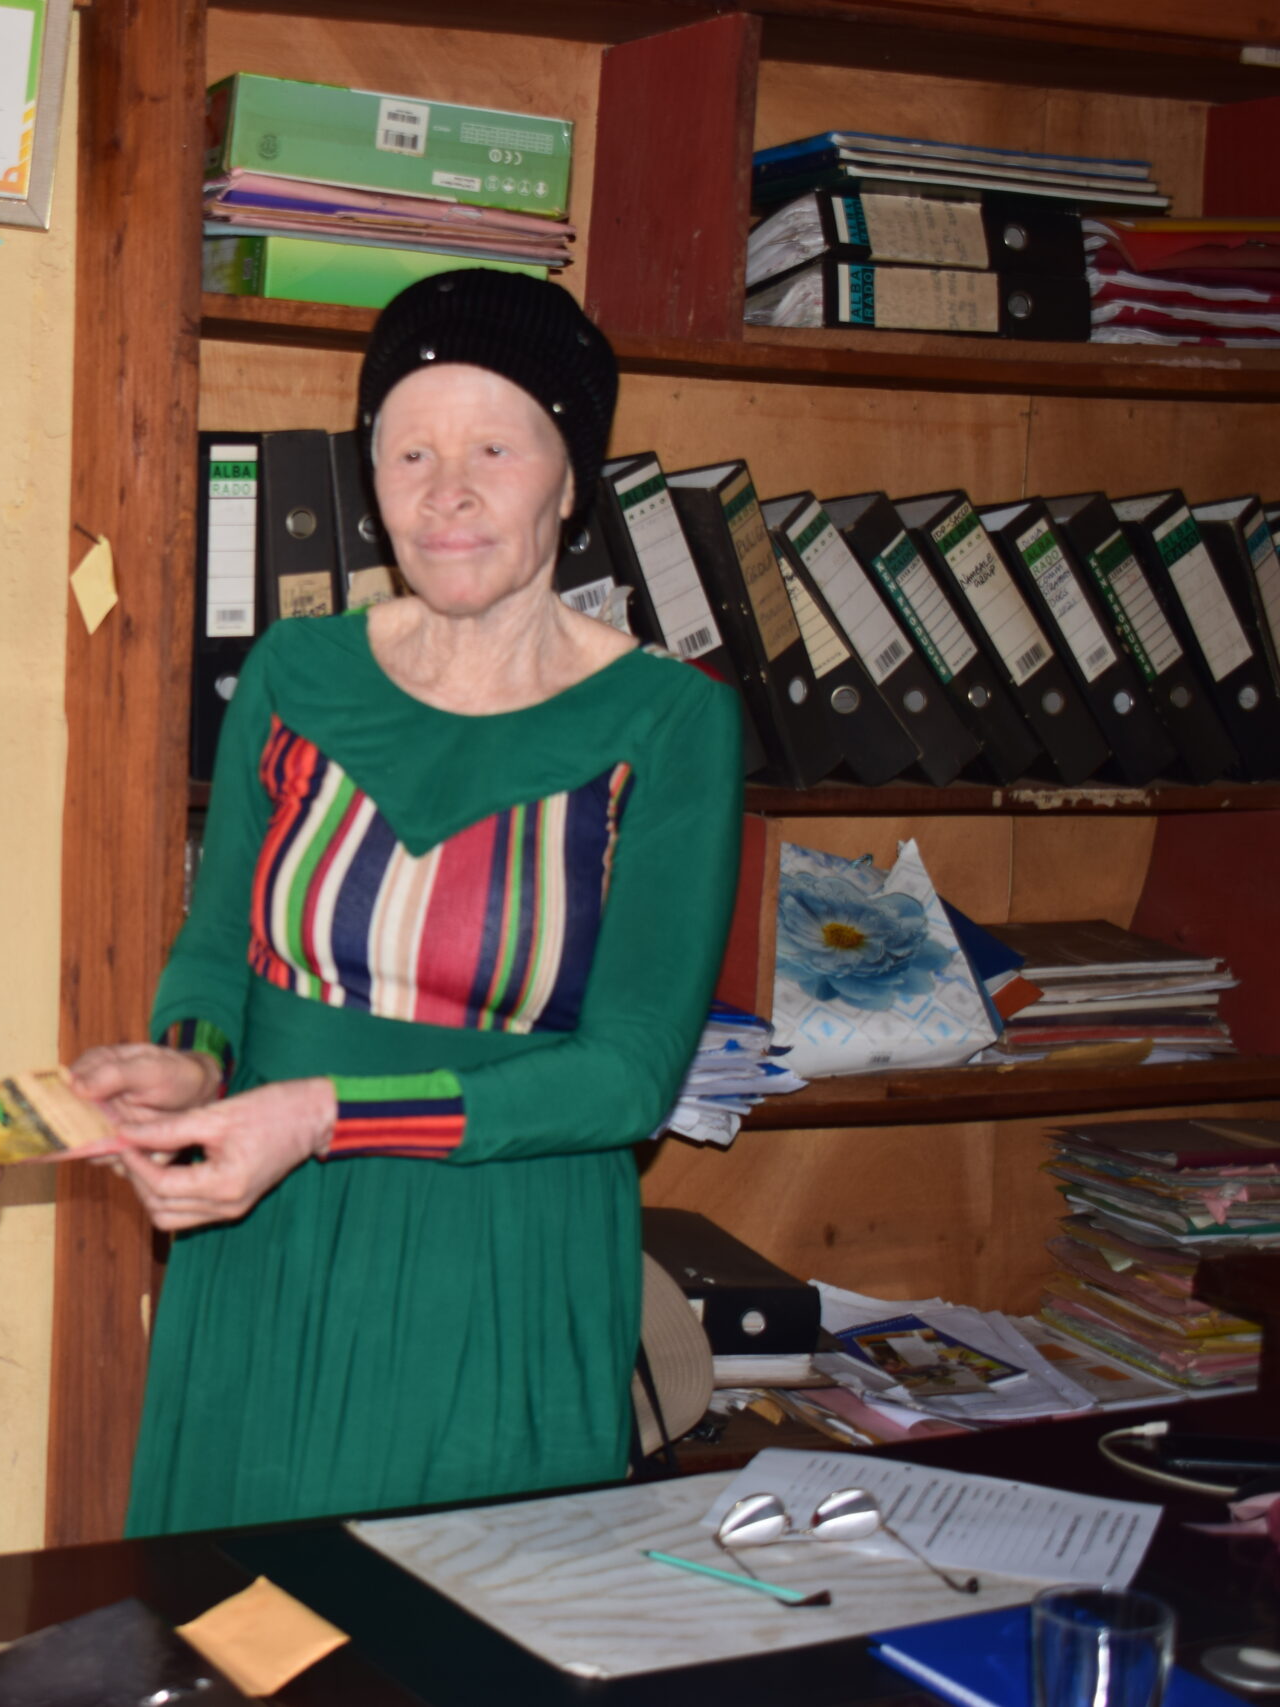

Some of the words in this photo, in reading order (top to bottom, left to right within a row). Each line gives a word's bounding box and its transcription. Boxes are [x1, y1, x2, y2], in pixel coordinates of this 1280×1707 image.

[850, 270, 862, 319] ALBA
[863, 272, 874, 321] RADO
[212, 464, 251, 478] ALBA
[211, 483, 251, 496] RADO
[623, 477, 666, 508] ALBA
[628, 497, 666, 521] RADO
[942, 515, 978, 552] ALBA
[1026, 535, 1053, 562] ALBA
[1032, 550, 1060, 577] RADO
